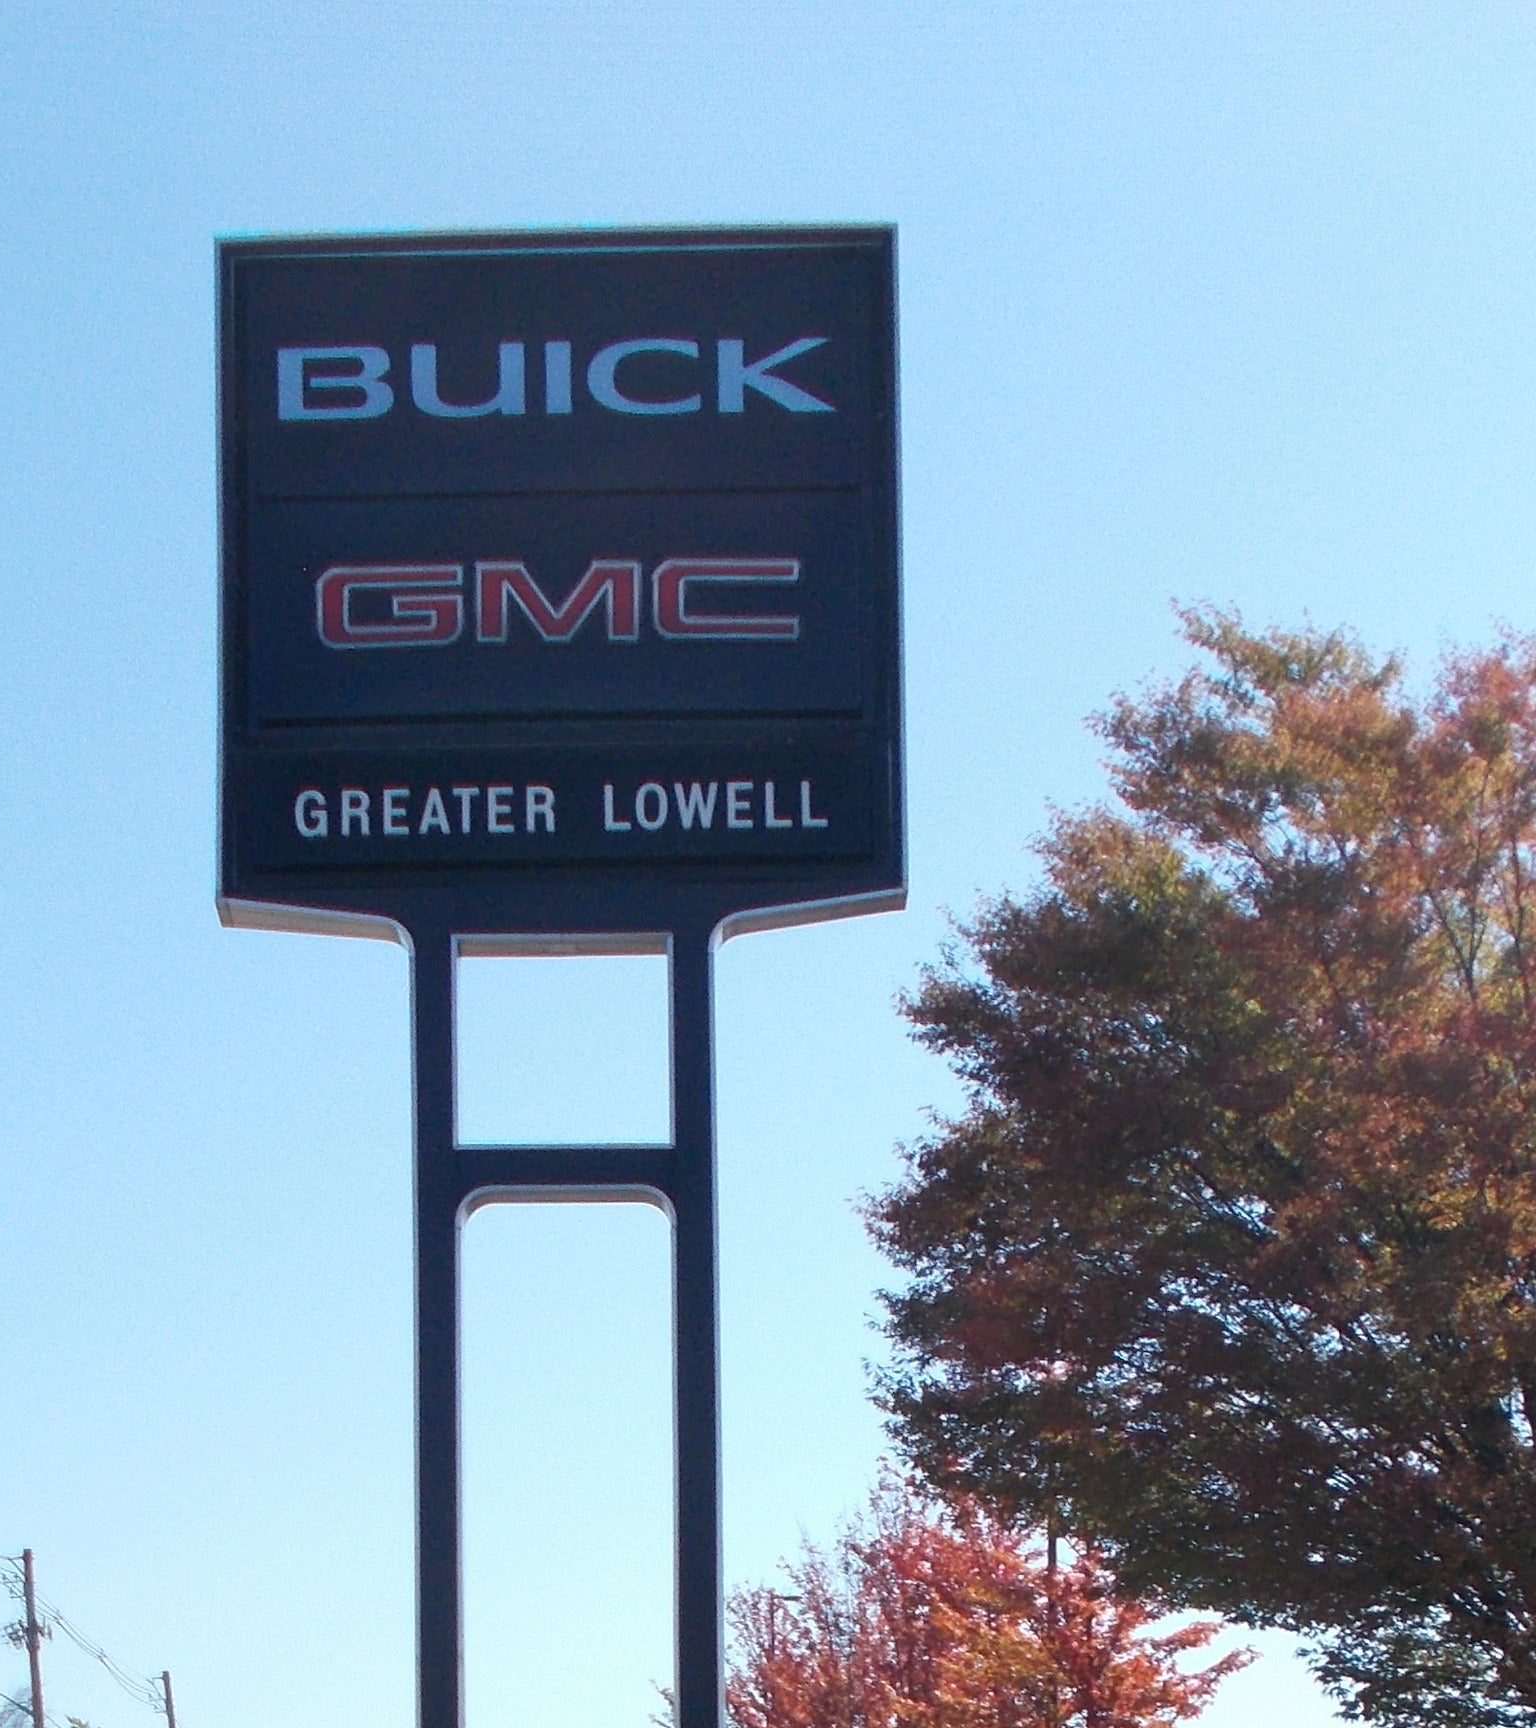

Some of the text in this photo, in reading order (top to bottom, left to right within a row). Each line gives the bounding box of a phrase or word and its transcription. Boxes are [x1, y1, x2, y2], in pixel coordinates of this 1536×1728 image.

[276, 337, 838, 421] BUICK
[315, 557, 801, 650] GMC
[293, 780, 829, 838] GREATER LOWELL
